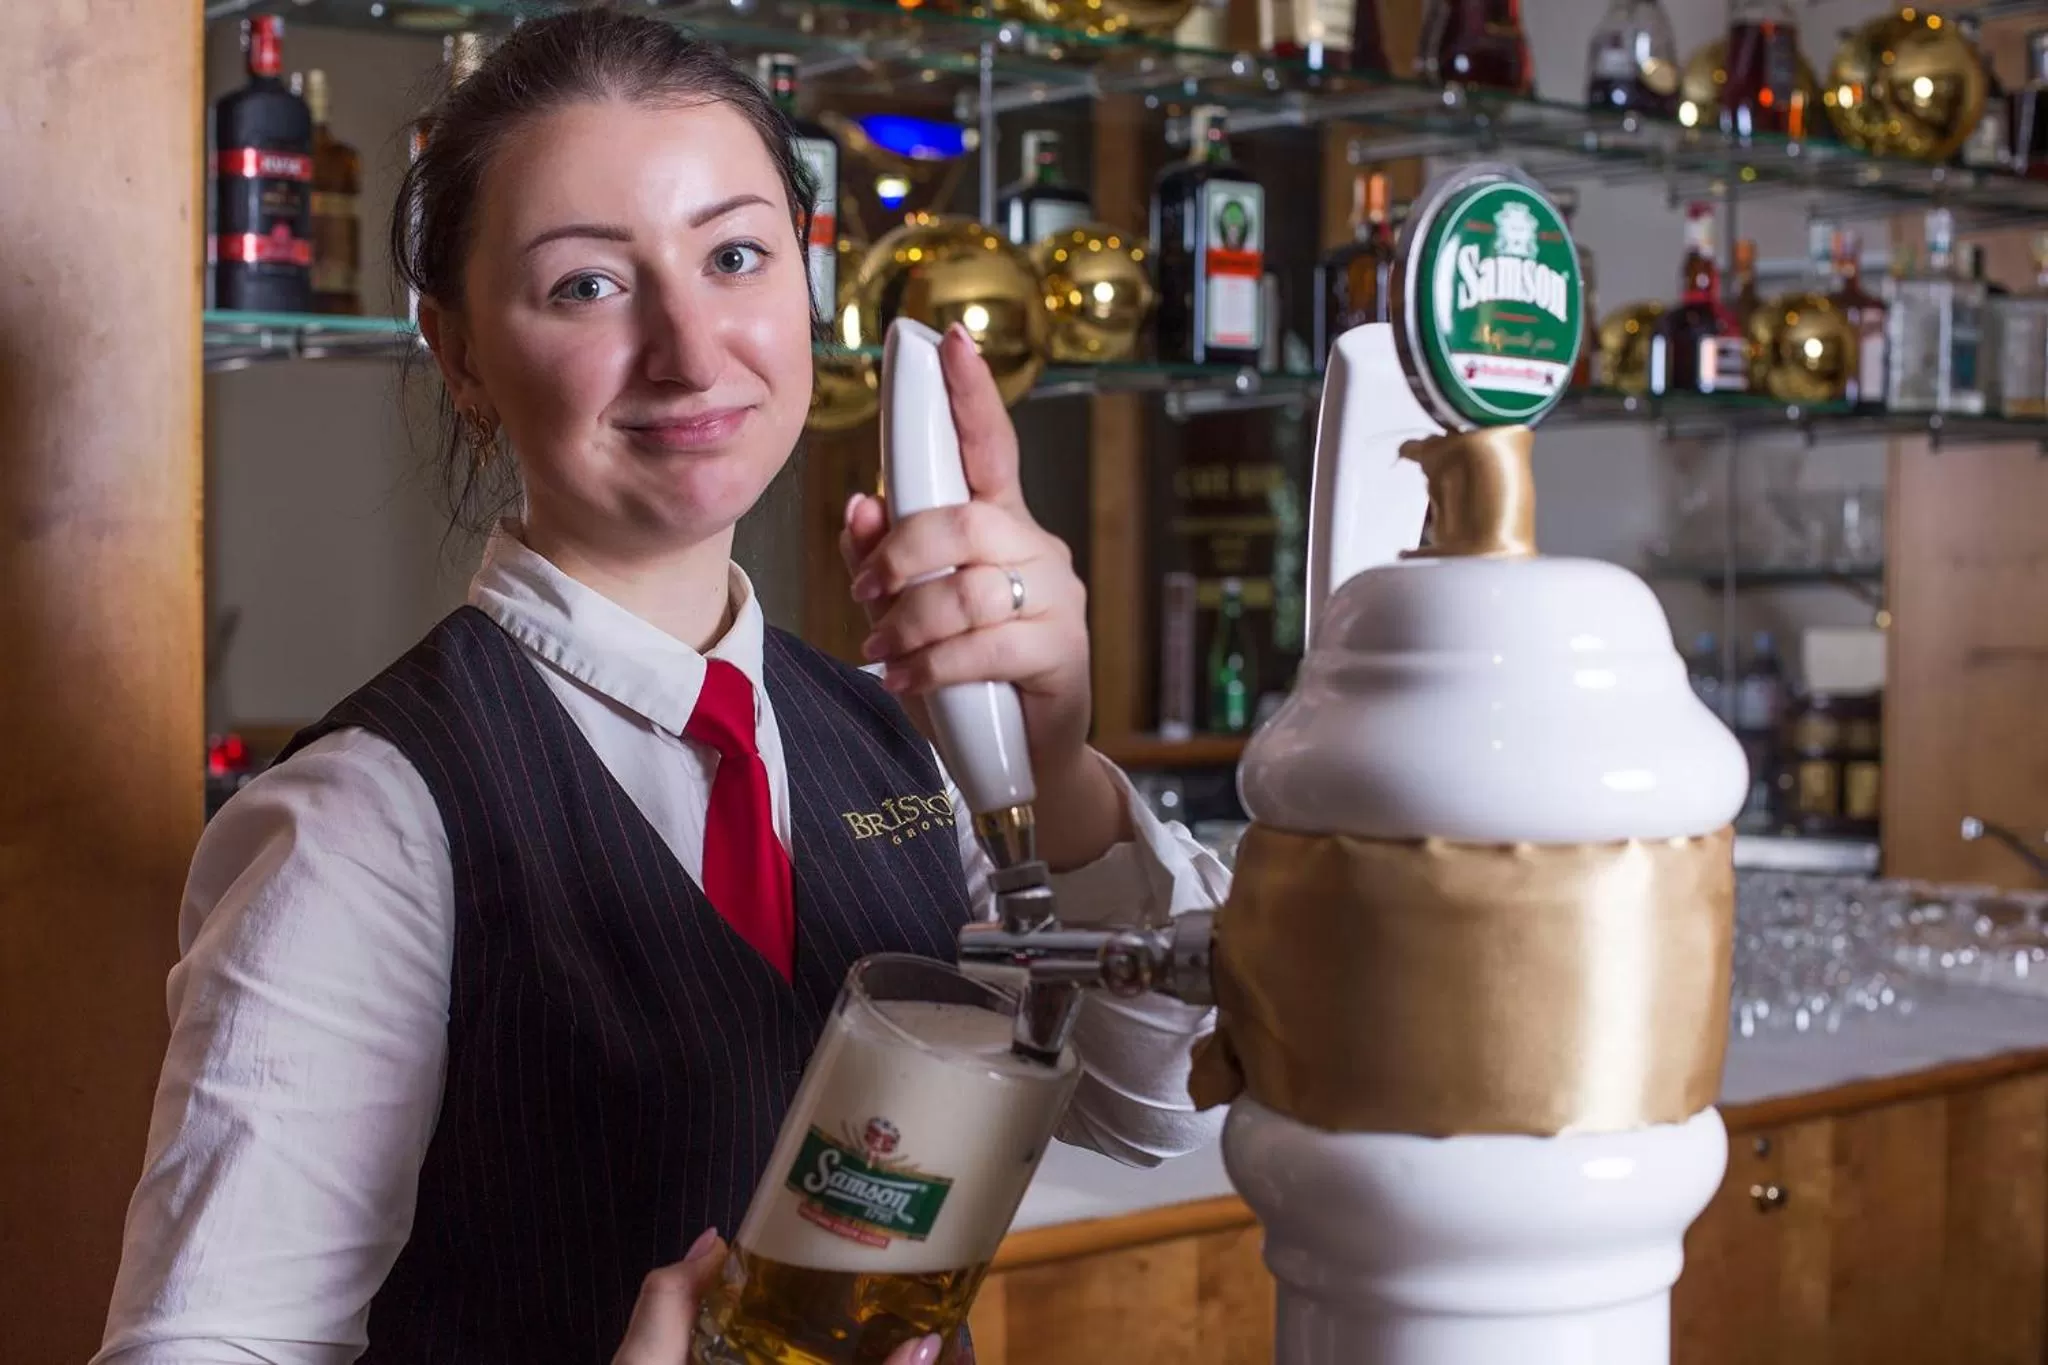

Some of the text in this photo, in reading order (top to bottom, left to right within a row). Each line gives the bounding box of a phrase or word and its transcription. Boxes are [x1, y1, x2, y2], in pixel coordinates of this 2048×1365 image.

[1457, 243, 1568, 324] Samson
[841, 789, 953, 840] BRISTO
[803, 1148, 916, 1225] Samson
